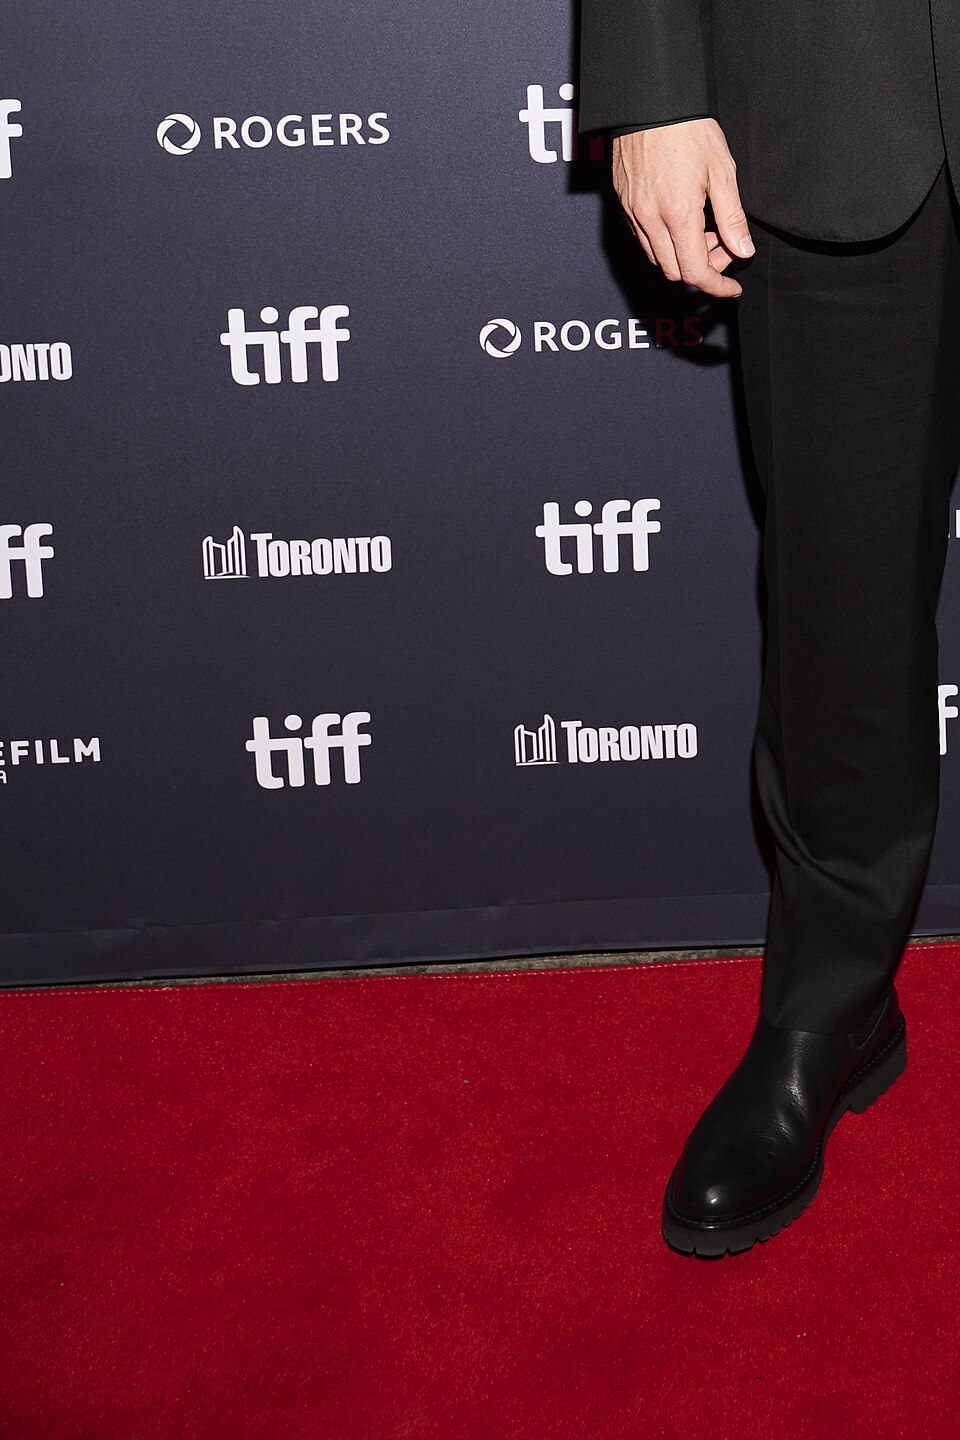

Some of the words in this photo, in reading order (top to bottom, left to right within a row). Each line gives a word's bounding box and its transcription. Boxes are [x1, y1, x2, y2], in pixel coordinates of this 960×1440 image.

[214, 113, 389, 149] ROGERS
[220, 305, 350, 385] tiff
[252, 533, 391, 577] TORONTO
[536, 499, 660, 575] tiff
[246, 712, 371, 789] tiff
[563, 721, 697, 762] TORONTO
